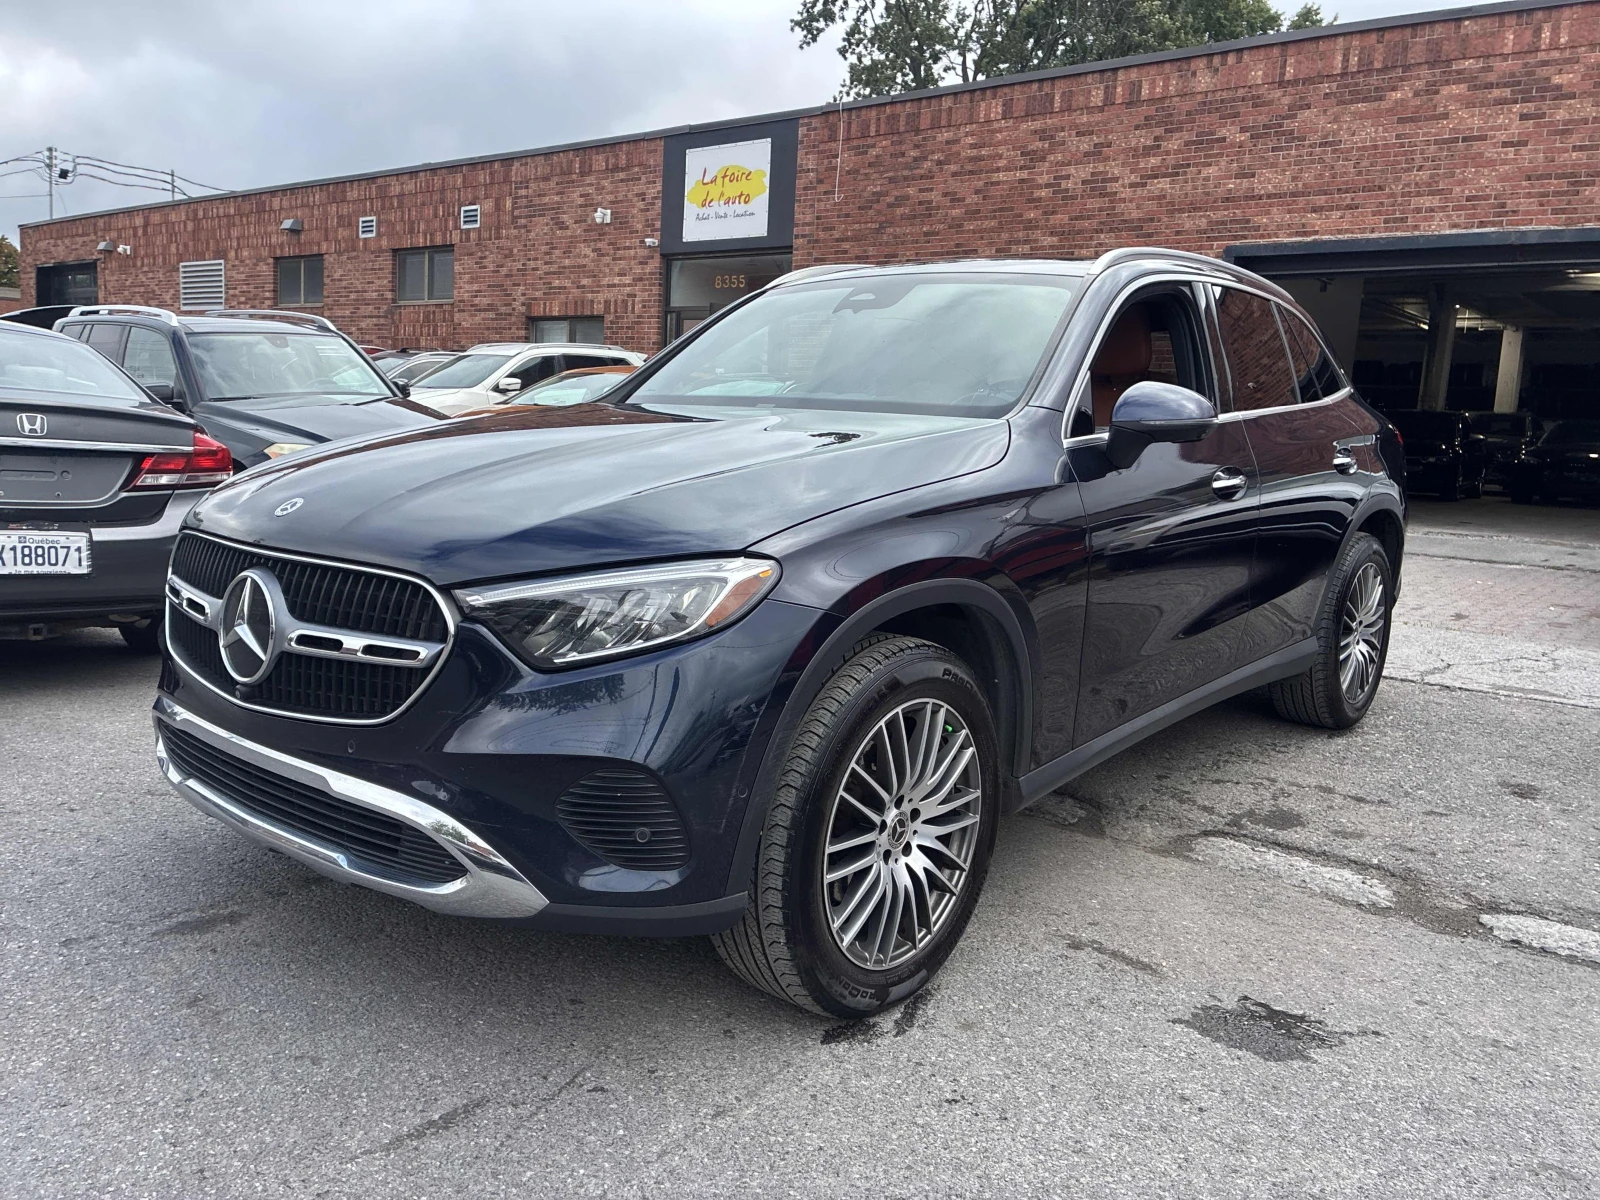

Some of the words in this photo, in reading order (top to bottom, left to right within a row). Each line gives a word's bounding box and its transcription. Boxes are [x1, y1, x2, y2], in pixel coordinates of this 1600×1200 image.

[701, 167, 718, 186] La
[720, 167, 753, 188] foire
[701, 191, 714, 209] de
[718, 190, 751, 207] l'auto
[695, 212, 710, 221] Achat
[714, 211, 728, 219] Vente
[732, 210, 756, 218] Location
[715, 275, 746, 289] 8355
[27, 537, 61, 545] Québec
